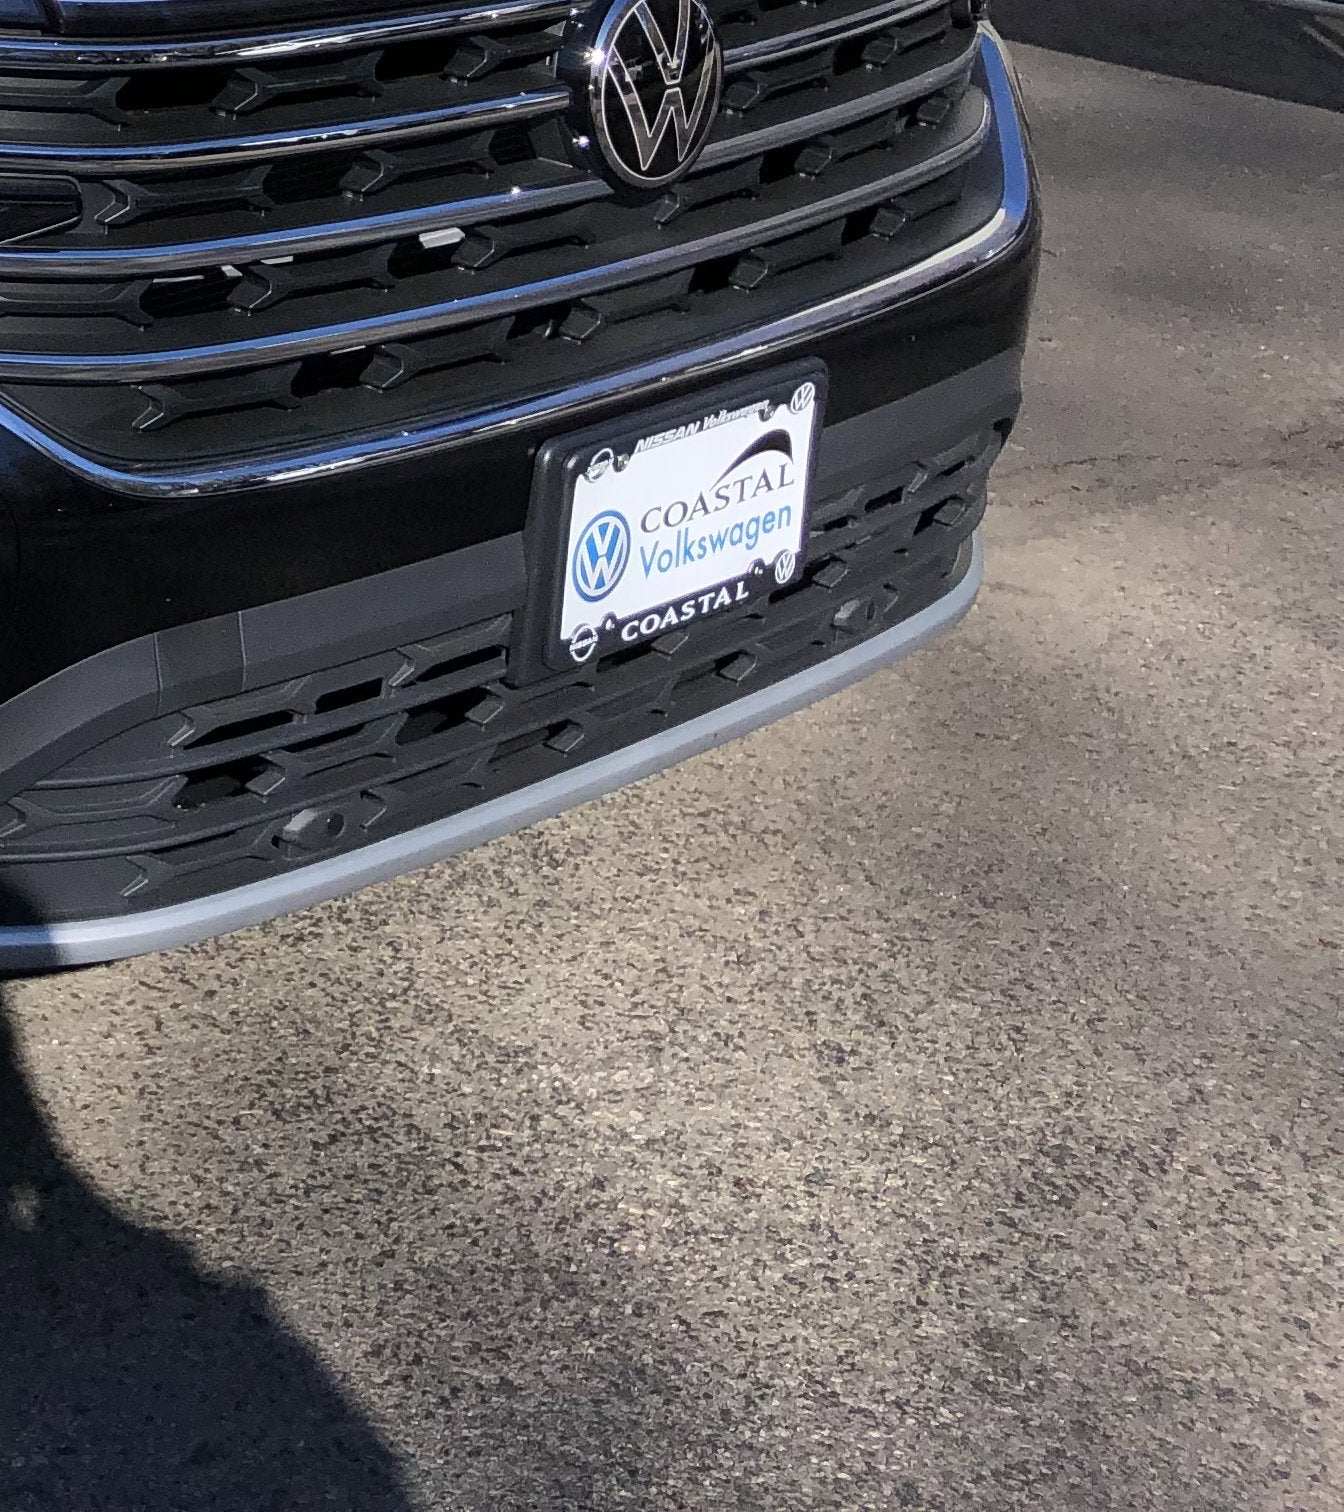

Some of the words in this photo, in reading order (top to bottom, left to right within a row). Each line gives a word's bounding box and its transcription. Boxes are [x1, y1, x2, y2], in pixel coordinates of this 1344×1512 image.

[633, 420, 702, 454] NISSAN
[640, 463, 795, 533] COASTAL
[639, 504, 792, 580] Volkswagen
[621, 580, 749, 642] COASTAL
